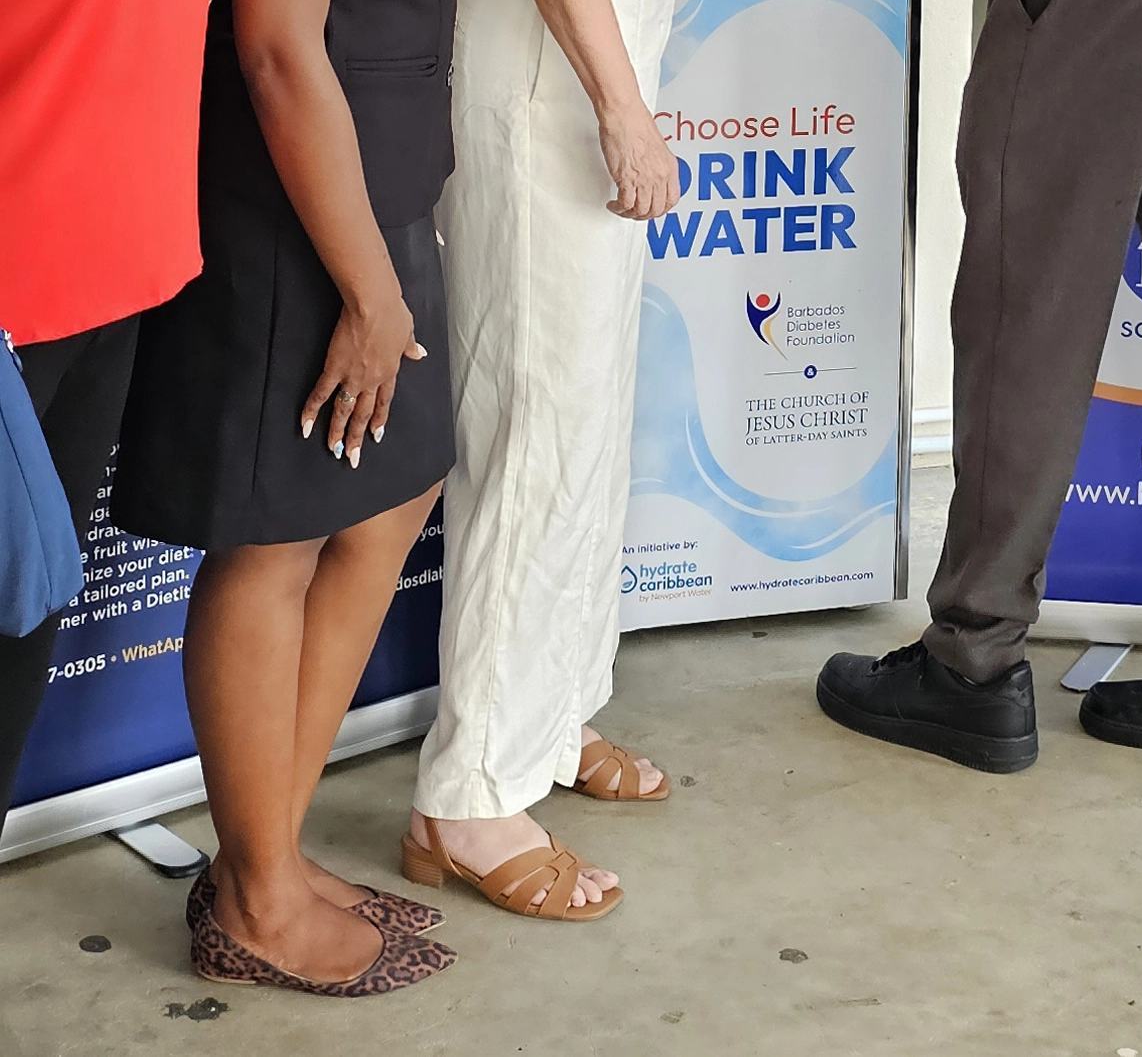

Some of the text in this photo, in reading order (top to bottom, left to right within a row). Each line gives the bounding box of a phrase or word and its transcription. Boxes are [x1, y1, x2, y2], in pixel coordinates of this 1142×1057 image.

[791, 104, 855, 136] Life
[647, 204, 857, 260] WATER
[787, 304, 845, 318] Barbados
[787, 319, 841, 333] Diabetes
[786, 332, 855, 347] Foundation
[807, 367, 815, 376] &
[746, 391, 870, 412] THE CHURCH OF
[745, 408, 868, 436] JESUS CHRIST
[746, 428, 867, 445] OF LATTER-DAY SAINTS
[93, 542, 128, 561] fruit
[637, 541, 681, 554] initiative
[683, 539, 699, 553] by:
[118, 555, 155, 577] your
[639, 560, 697, 580] hydrate
[84, 574, 147, 603] tailored
[151, 568, 190, 590] plan.
[639, 573, 713, 592] caribbean
[730, 570, 874, 593] www.hydratecaribbean.com
[92, 598, 128, 622] with
[132, 599, 142, 612] a
